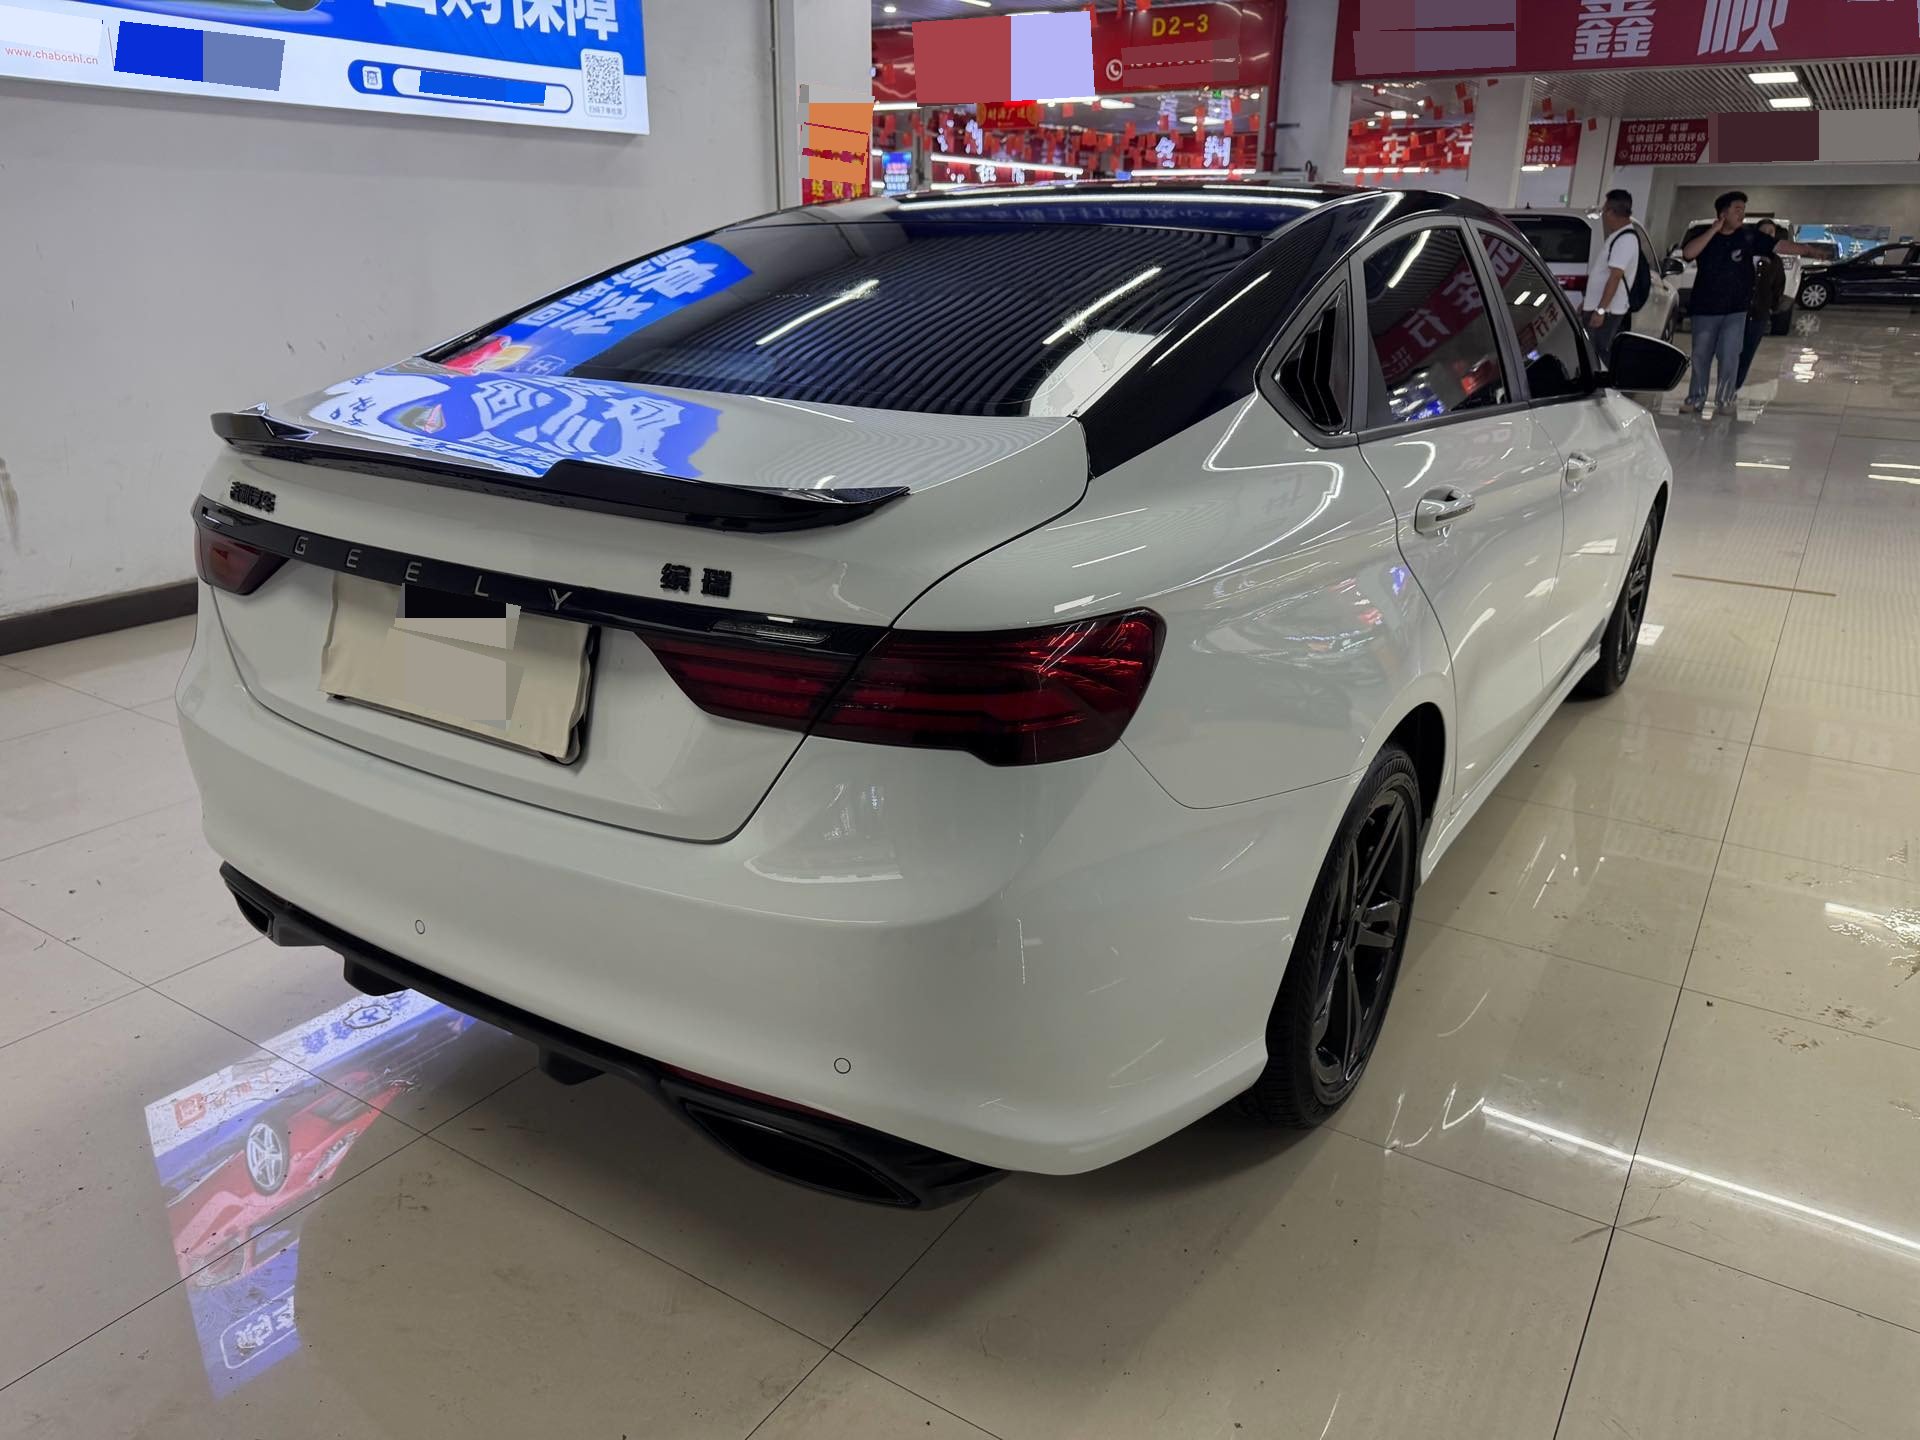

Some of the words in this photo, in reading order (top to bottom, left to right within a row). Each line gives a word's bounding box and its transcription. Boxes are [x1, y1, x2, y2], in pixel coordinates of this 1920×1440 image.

[1151, 14, 1209, 37] D2-3
[5, 47, 98, 65] www.chaboshi.cn
[294, 536, 572, 611] GEELY
